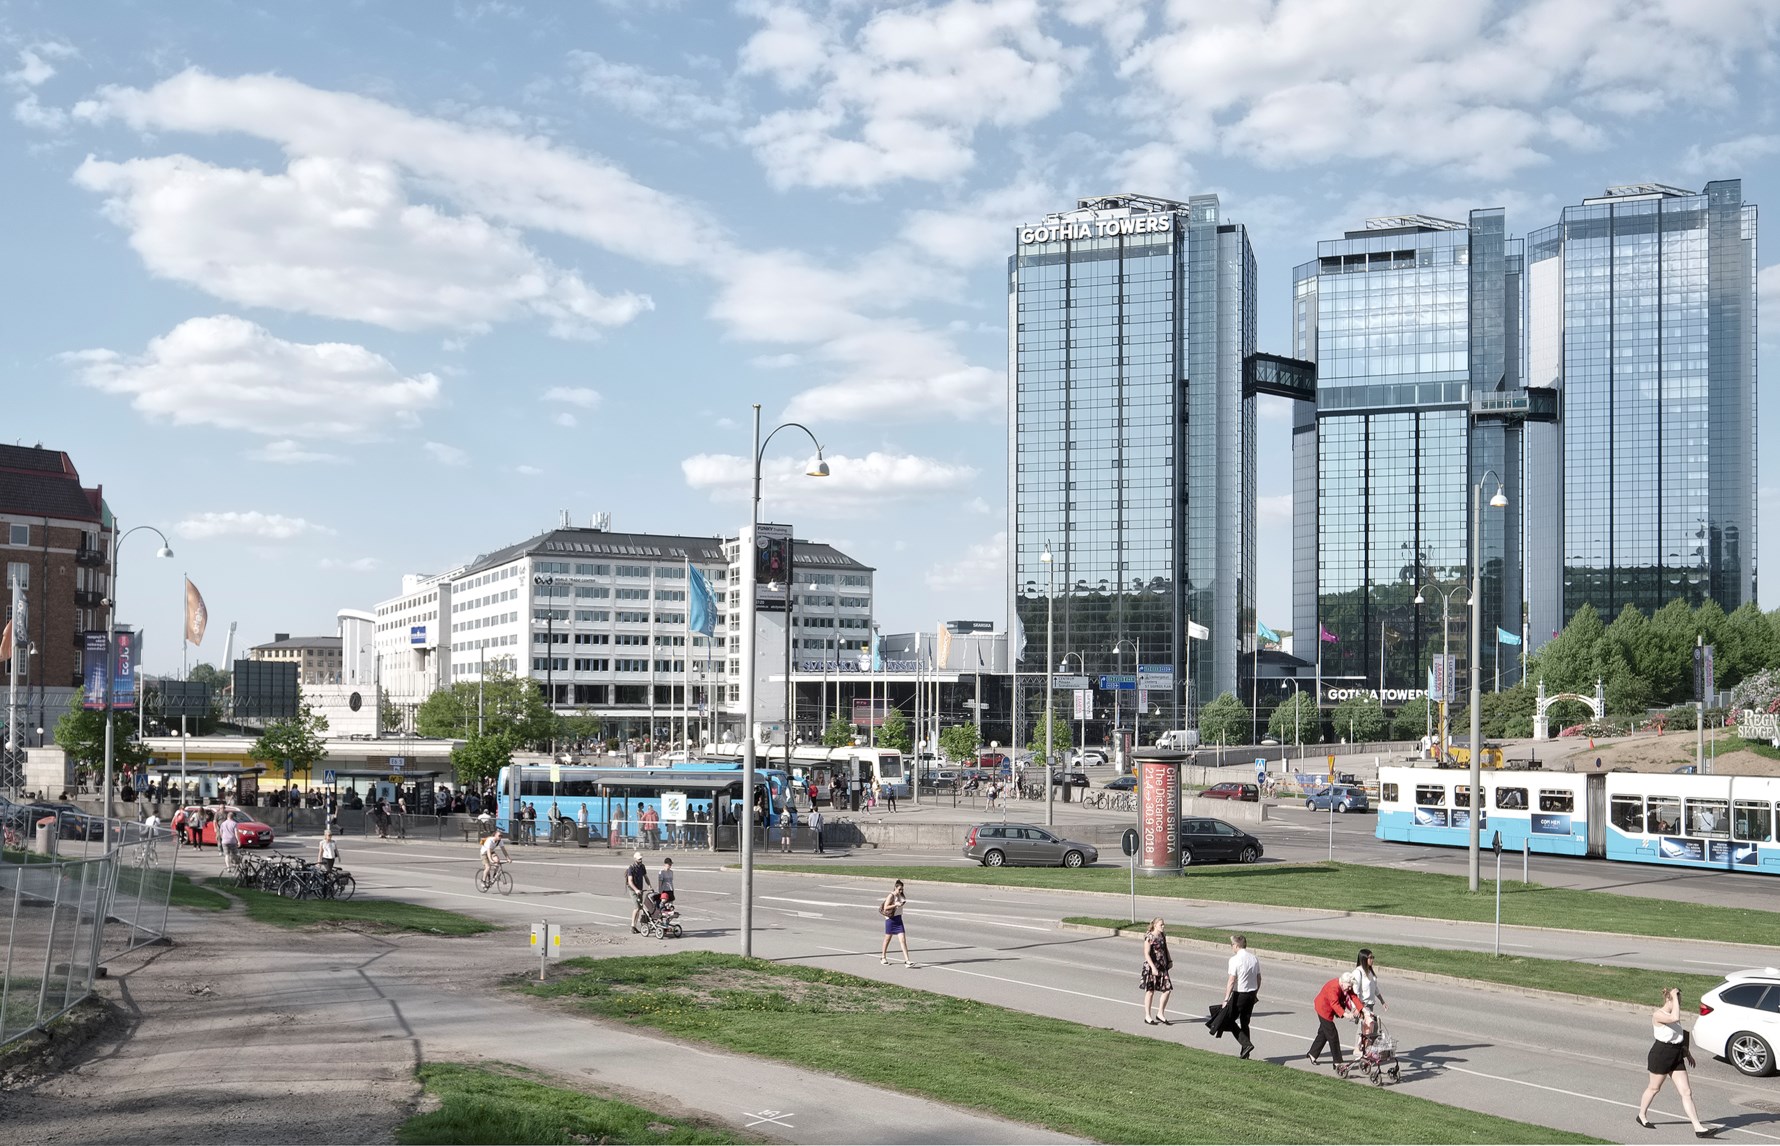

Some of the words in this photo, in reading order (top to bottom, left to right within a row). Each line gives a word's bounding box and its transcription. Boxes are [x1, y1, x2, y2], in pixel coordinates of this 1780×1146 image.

[1020, 223, 1092, 244] GOTHIA
[1096, 215, 1170, 237] TOWERS
[803, 660, 860, 672] SVENSKA
[1743, 709, 1779, 727] REGN
[1156, 768, 1165, 785] The
[1167, 768, 1175, 813] CHIHARU
[1156, 788, 1165, 832] Distance
[1145, 828, 1154, 853] 2018
[1167, 817, 1175, 853] SHIOTA
